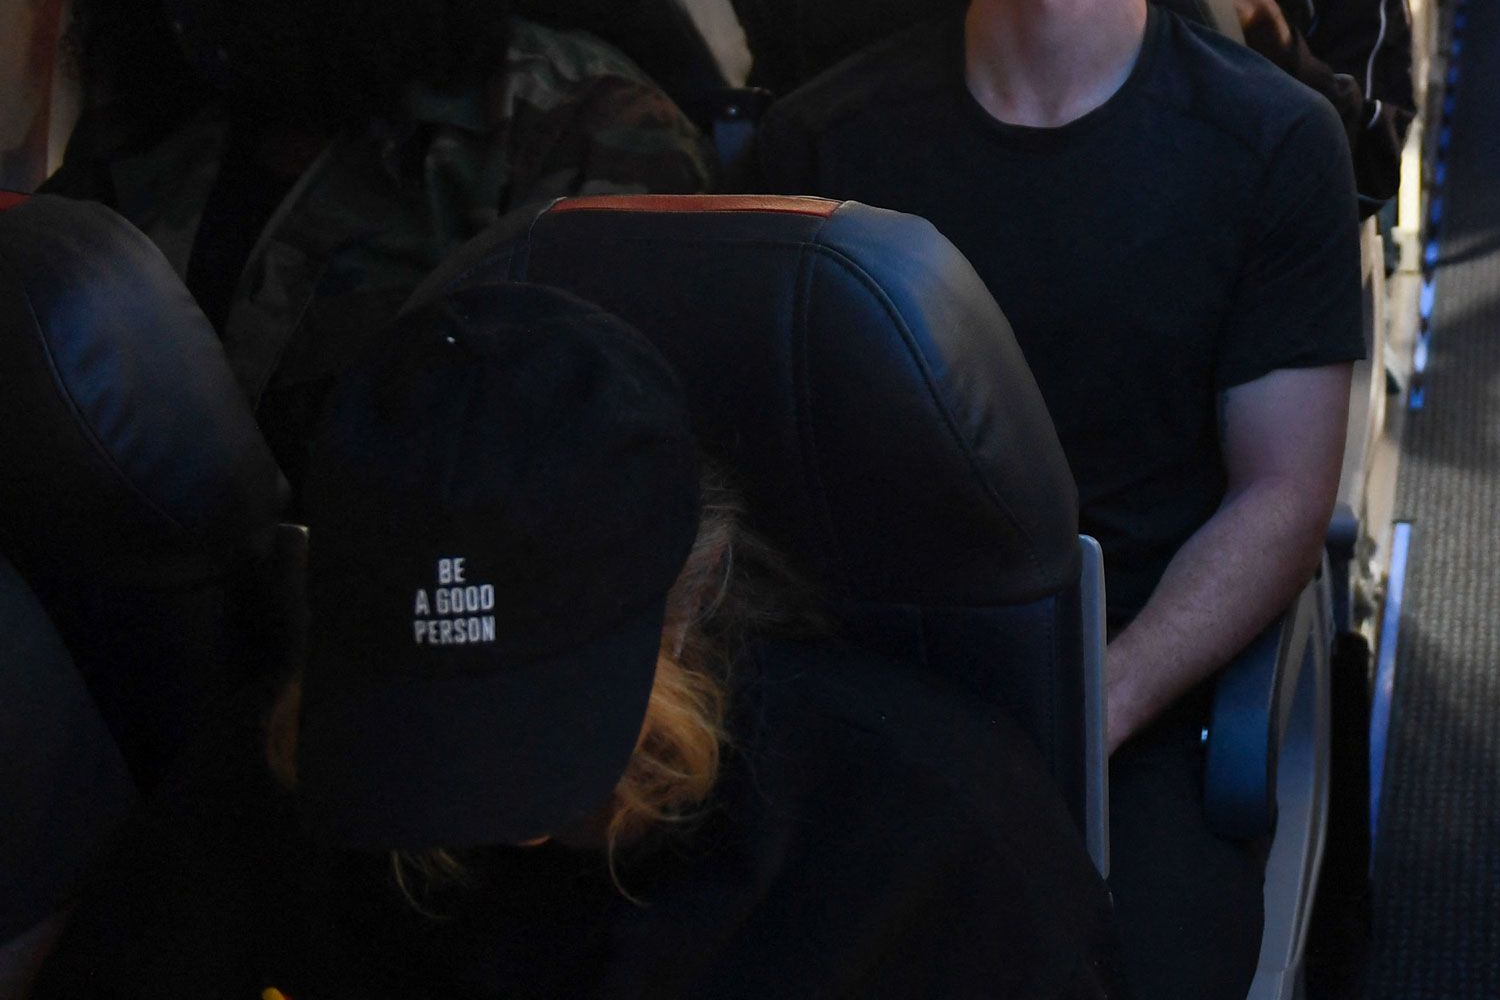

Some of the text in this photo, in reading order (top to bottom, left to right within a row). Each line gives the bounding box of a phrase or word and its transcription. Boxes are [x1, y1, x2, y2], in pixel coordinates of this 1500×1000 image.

[438, 557, 466, 584] BE
[414, 583, 495, 615] A GOOD
[413, 615, 497, 644] PERSON
